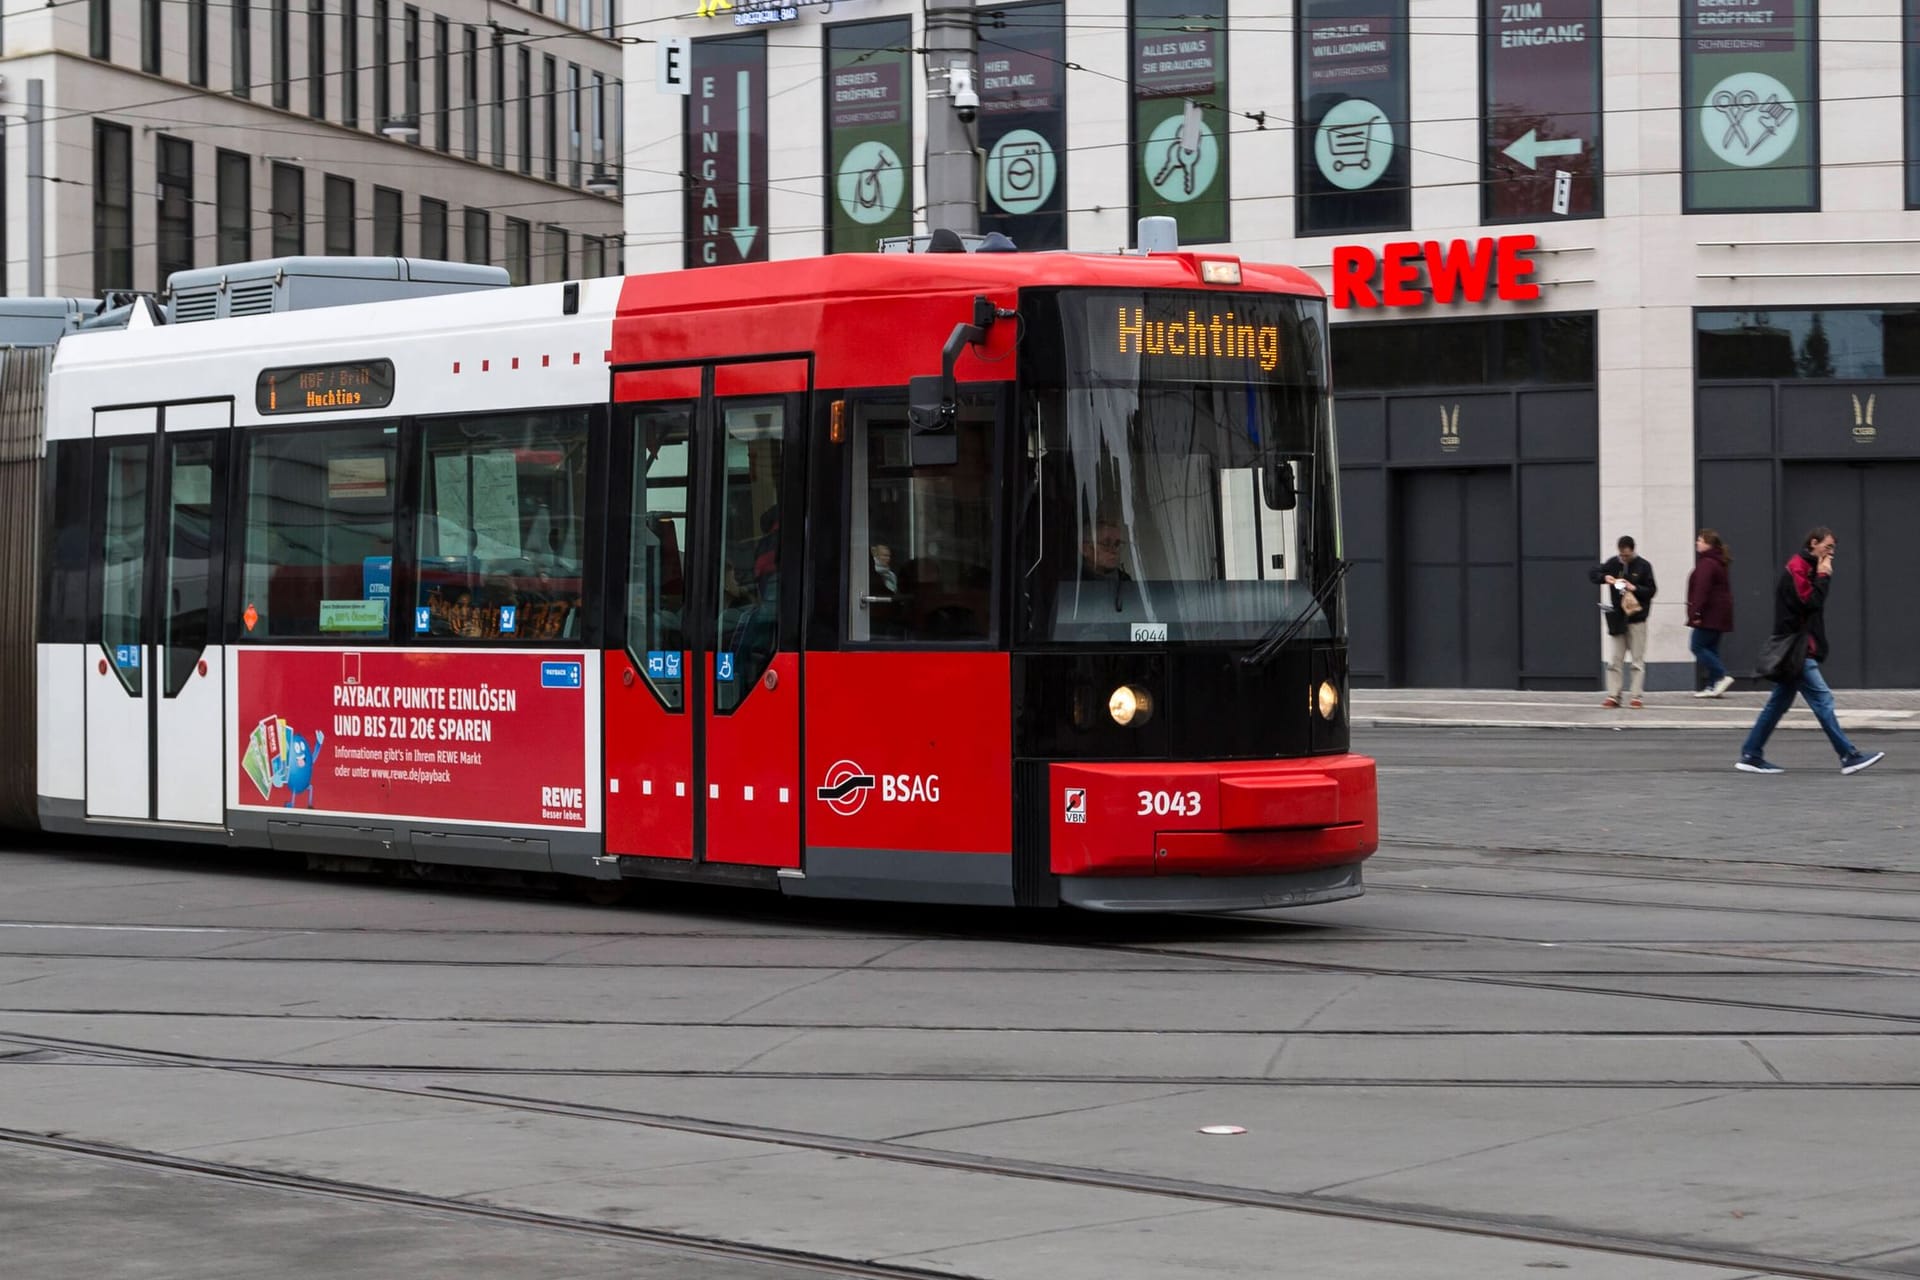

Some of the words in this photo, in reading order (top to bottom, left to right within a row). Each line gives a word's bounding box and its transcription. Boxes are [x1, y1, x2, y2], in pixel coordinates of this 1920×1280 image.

[1501, 2, 1542, 22] ZUM
[1697, 9, 1774, 24] ERÖFFNET
[1501, 23, 1585, 48] EINGANG
[1142, 42, 1177, 56] ALLES
[1179, 40, 1207, 53] WAS
[1312, 40, 1386, 56] WILLKOMMEN
[666, 47, 681, 84] E
[984, 60, 1010, 72] HIER
[1142, 63, 1157, 73] SIE
[1159, 57, 1212, 72] BRAUCHEN
[984, 74, 1035, 89] ENTLANG
[835, 86, 888, 102] ERÖFFNET
[1333, 235, 1539, 309] REWE
[1119, 308, 1278, 371] Huchting
[306, 389, 361, 408] Huchting
[1134, 628, 1165, 641] 6044
[333, 685, 390, 708] PAYBACK
[393, 687, 446, 710] PUNKTE
[449, 683, 517, 712] EINLÖSEN
[334, 715, 361, 737] UND
[364, 716, 387, 738] BIS
[389, 716, 407, 739] ZU
[410, 717, 435, 740] 20€
[438, 718, 492, 742] SPAREN
[334, 745, 383, 761] Informationen
[383, 747, 404, 764] gibt's
[405, 750, 413, 762] in
[414, 749, 436, 763] Ihrem
[437, 751, 458, 764] REWE
[460, 752, 481, 765] Markt
[334, 765, 351, 777] oder
[351, 767, 370, 778] unter
[371, 768, 451, 785] www.rewe.de/payback
[542, 786, 583, 809] REWE
[882, 775, 940, 802] BSAG
[1137, 791, 1201, 816] 3043
[542, 808, 562, 820] Besser
[563, 809, 583, 821] leben.
[1066, 813, 1085, 823] VBN
